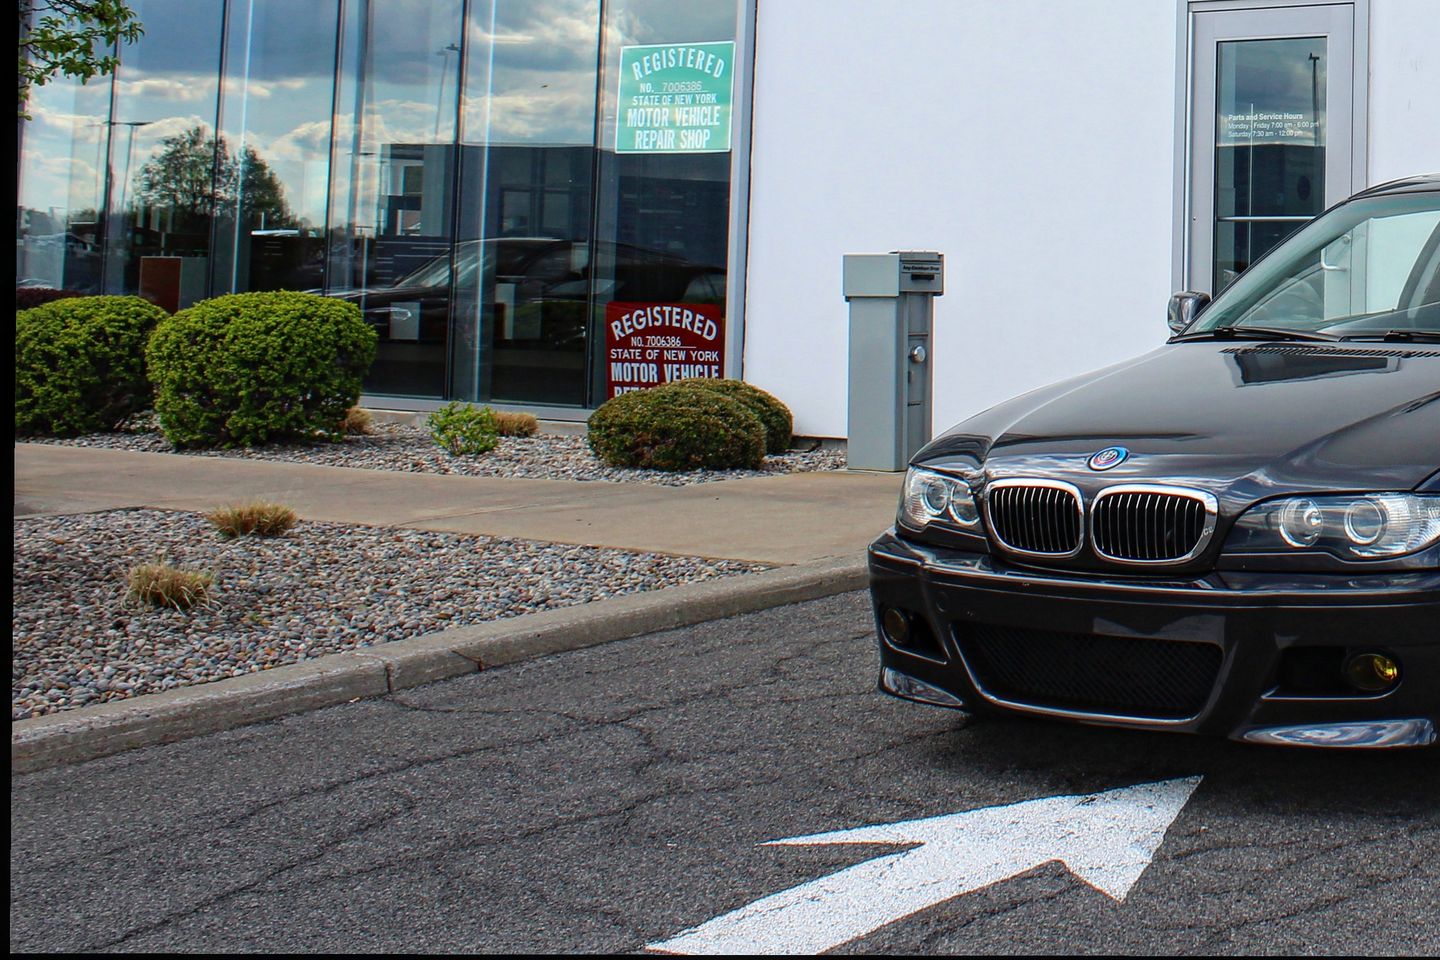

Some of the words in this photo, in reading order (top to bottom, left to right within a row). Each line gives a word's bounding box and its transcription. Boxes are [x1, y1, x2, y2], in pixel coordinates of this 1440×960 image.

[632, 48, 725, 81] REGISTERED
[640, 83, 654, 93] NO.
[662, 81, 703, 91] 7006386
[632, 95, 659, 106] STATE
[661, 95, 672, 105] OF
[674, 94, 692, 105] NEW
[695, 93, 717, 104] YORK
[627, 107, 669, 128] MOTOR
[675, 105, 721, 127] VEHICLE
[1253, 122, 1270, 130] Friday
[635, 129, 675, 149] REPAIR
[680, 129, 711, 149] SHOP
[610, 306, 717, 341] REGISTERED
[631, 336, 644, 347] NO.
[646, 335, 681, 347] 7006386
[610, 349, 642, 360] STATE
[646, 349, 660, 360] OF
[664, 350, 686, 361] NEW
[690, 350, 719, 362] YORK
[611, 362, 658, 383] MOTOR
[664, 363, 719, 383] VEHICLE
